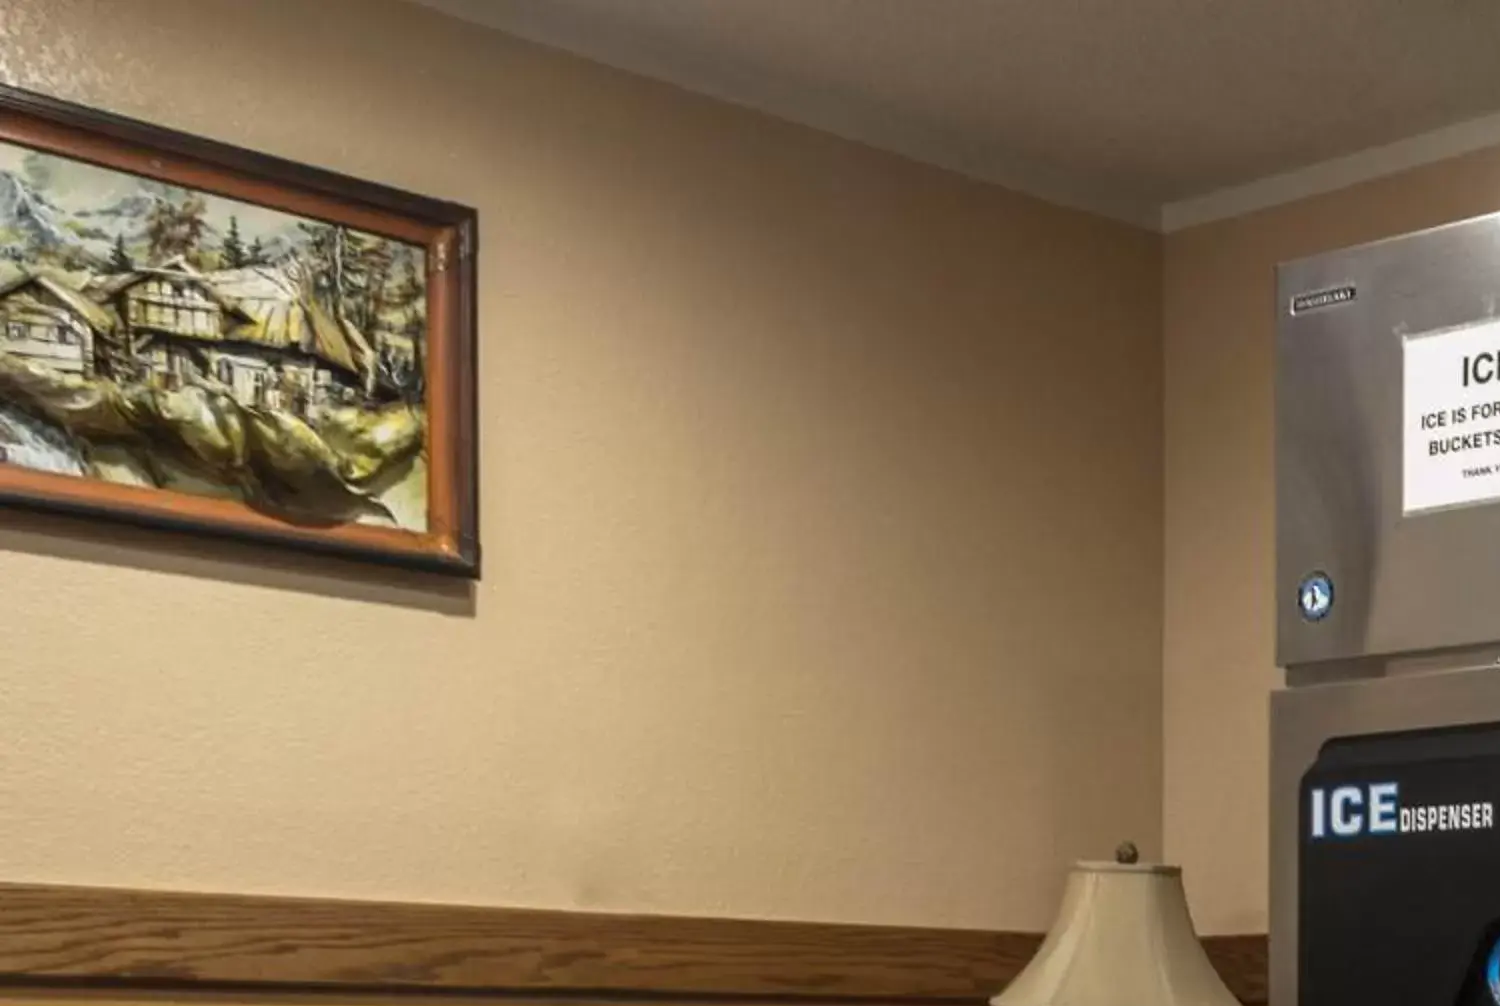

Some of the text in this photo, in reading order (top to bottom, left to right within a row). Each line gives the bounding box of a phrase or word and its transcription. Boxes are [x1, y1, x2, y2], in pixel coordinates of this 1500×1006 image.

[1421, 411, 1447, 430] ICE
[1451, 408, 1467, 424] IS
[1462, 465, 1493, 478] THANK
[1311, 781, 1494, 838] ICE DISPENSER
